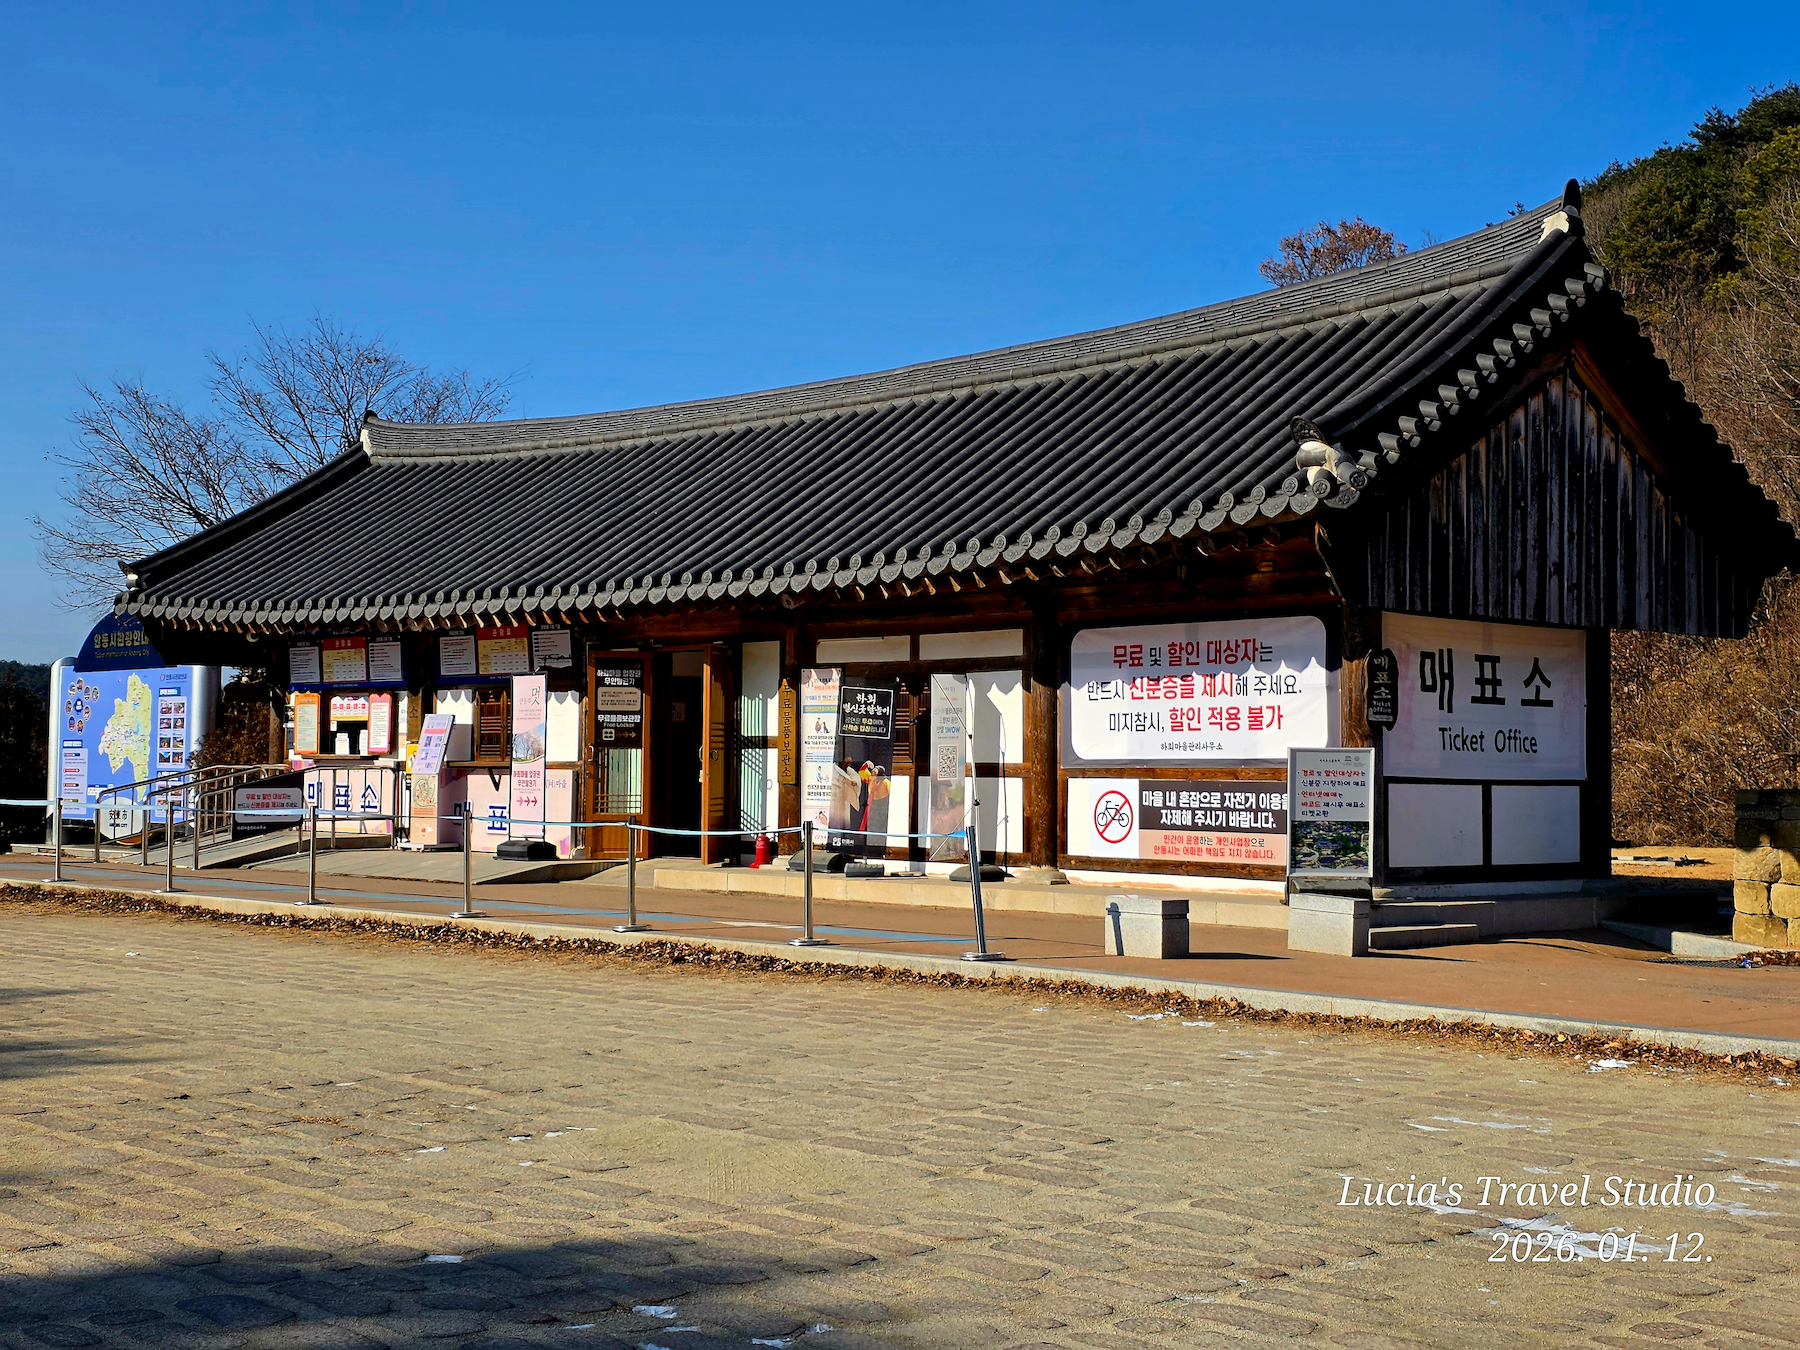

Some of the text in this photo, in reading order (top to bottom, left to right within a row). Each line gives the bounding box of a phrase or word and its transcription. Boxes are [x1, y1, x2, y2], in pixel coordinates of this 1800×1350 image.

[1112, 638, 1273, 669] 무료 및 할인 대상자는
[1087, 673, 1302, 701] 반드시 신분증을 제시해 주세요.
[1373, 655, 1391, 698] 매표소
[1419, 648, 1554, 714] 매표소
[856, 692, 877, 704] 하회
[1109, 705, 1283, 733] 미지참시, 할인 적용 불가
[1160, 741, 1223, 751] 하회마을관리사무소
[1438, 727, 1538, 754] Ticket Office
[1142, 790, 1163, 808] 마을
[1165, 790, 1177, 808] 내
[1179, 790, 1222, 809] 혼잡으로
[1223, 792, 1257, 810] 자전거
[1160, 809, 1277, 829] 자제해 주시기 바랍니다.
[1153, 845, 1180, 856] 안동시는
[1205, 847, 1226, 858] 책임도
[1229, 848, 1242, 858] 지지
[1244, 849, 1276, 860] 않습니다.
[1163, 834, 1265, 848] 민간이 운영하는 개인사업장으로
